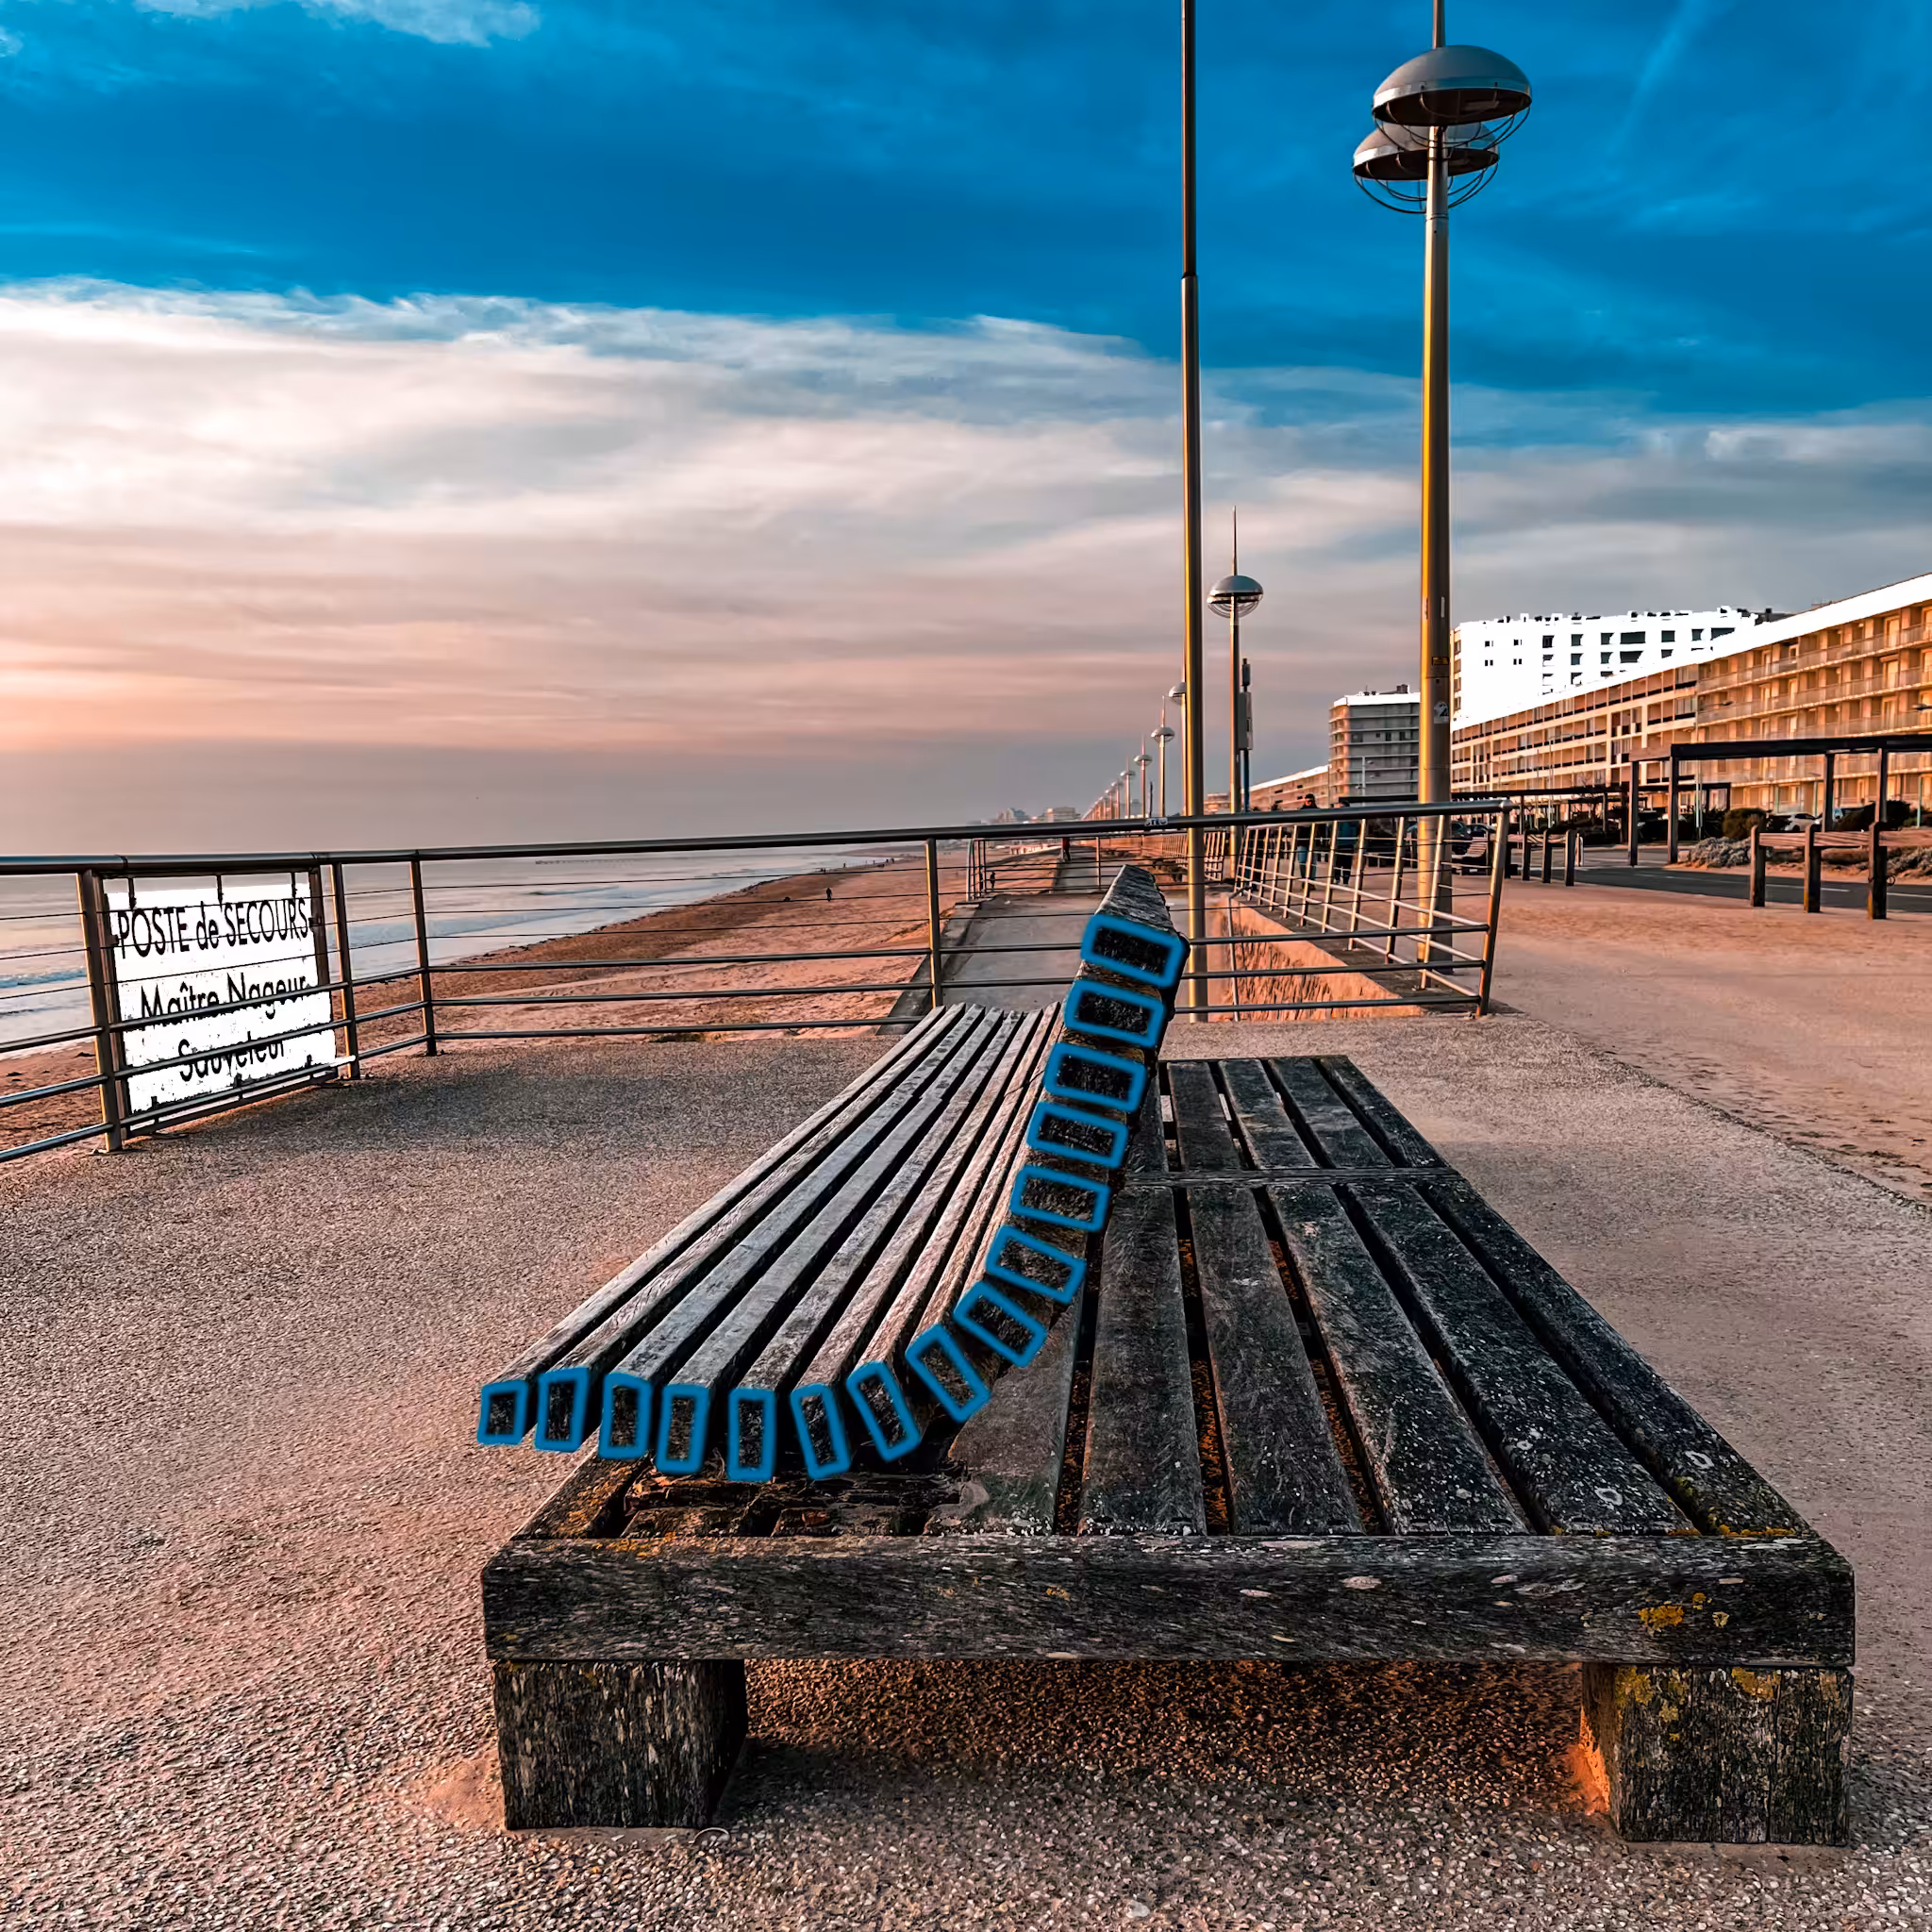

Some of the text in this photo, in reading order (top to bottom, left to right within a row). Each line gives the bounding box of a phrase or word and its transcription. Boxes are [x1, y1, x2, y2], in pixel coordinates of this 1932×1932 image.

[118, 898, 308, 958] POSTE de SECOURS
[142, 973, 306, 1030] Maître Nageur
